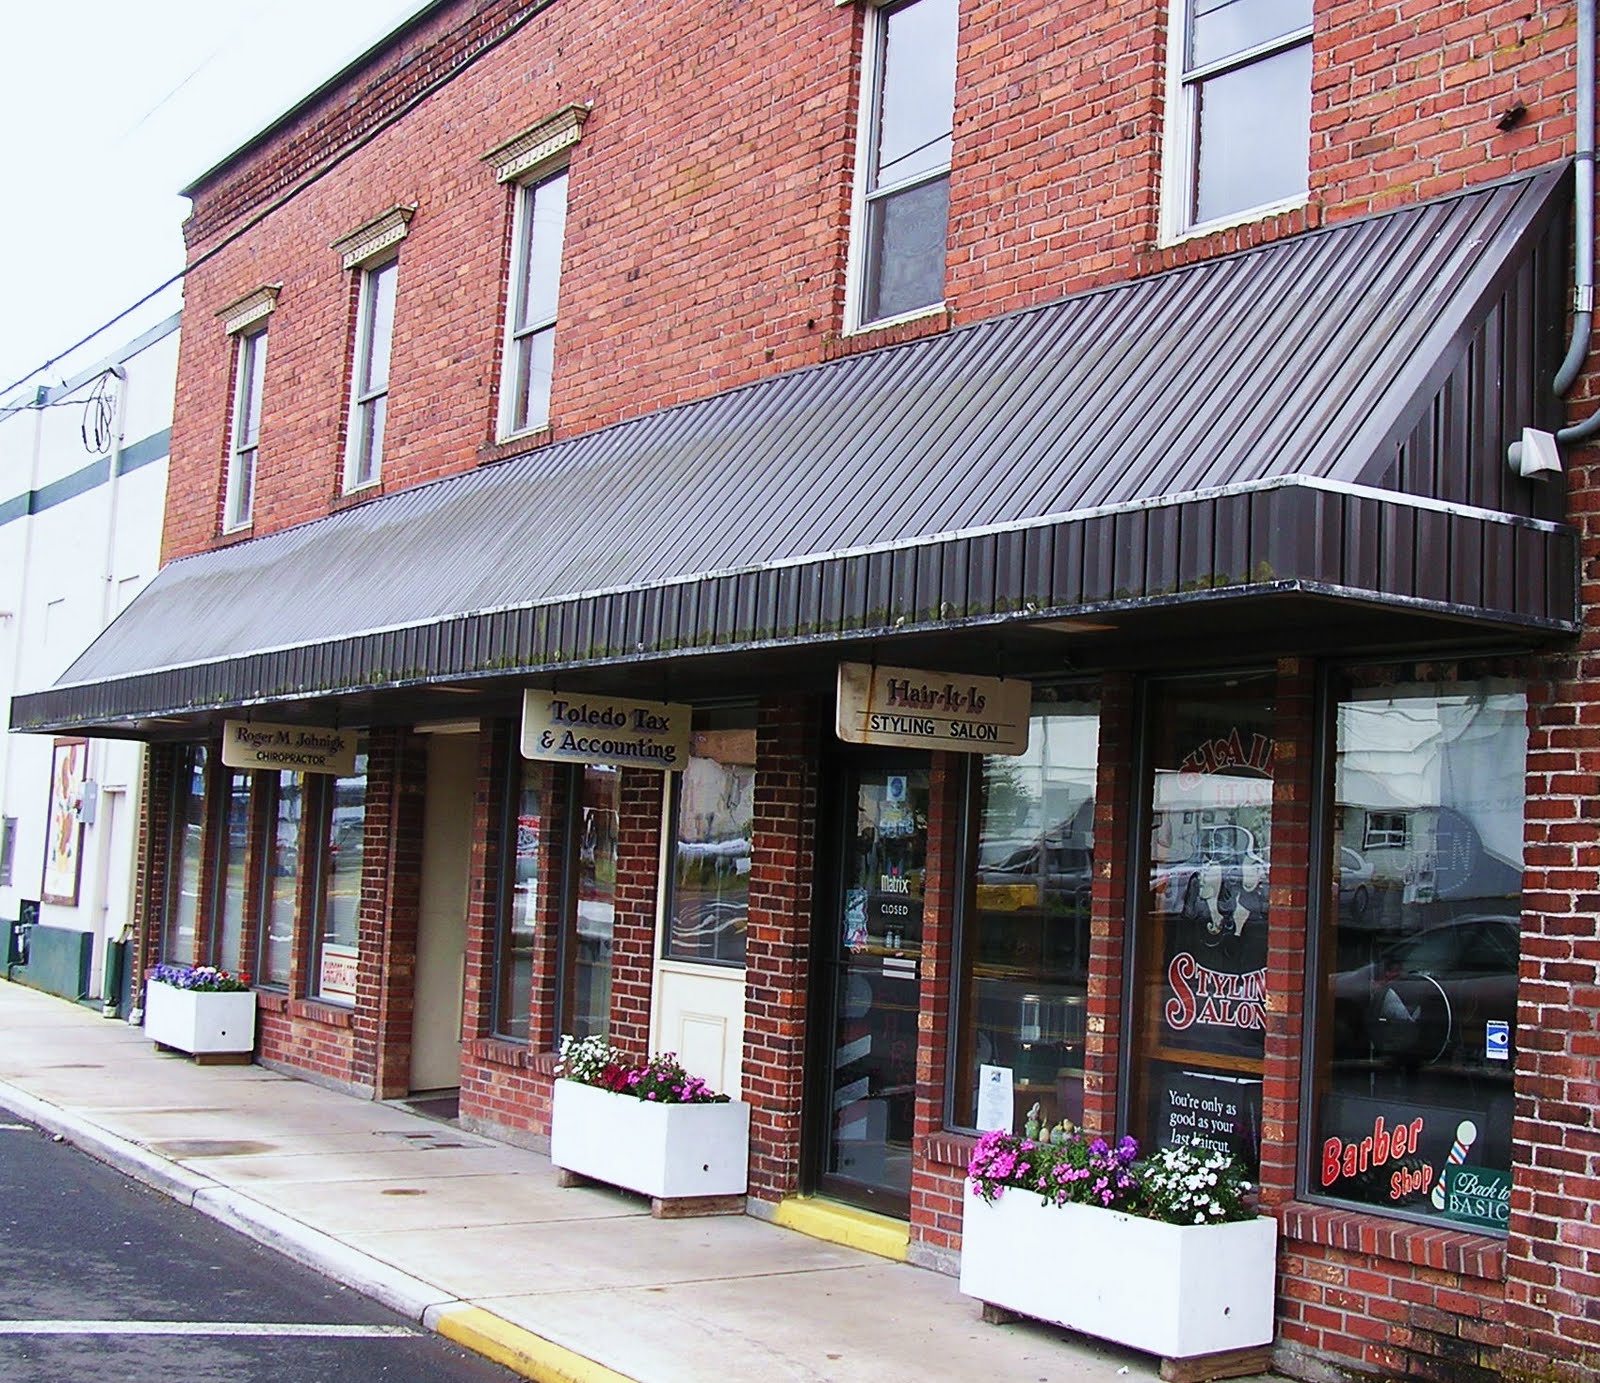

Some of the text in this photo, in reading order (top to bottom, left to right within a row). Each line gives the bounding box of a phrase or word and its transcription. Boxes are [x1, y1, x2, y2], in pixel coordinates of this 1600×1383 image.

[550, 700, 671, 732] Toledo Tax
[871, 715, 998, 741] STYLING SALON
[236, 727, 274, 747] Roger
[540, 730, 677, 762] & Accounting
[256, 751, 326, 766] CHIROPRACTOR
[881, 874, 909, 894] Matrix
[881, 904, 909, 915] CLOSED
[1165, 952, 1268, 1030] STYLIN
[1168, 1089, 1237, 1117] You're only as
[1169, 1111, 1234, 1134] good as your
[1171, 1128, 1190, 1146] last
[1322, 1116, 1424, 1187] Barber
[1452, 1172, 1512, 1201] Back to
[1449, 1194, 1510, 1221] BASIC
